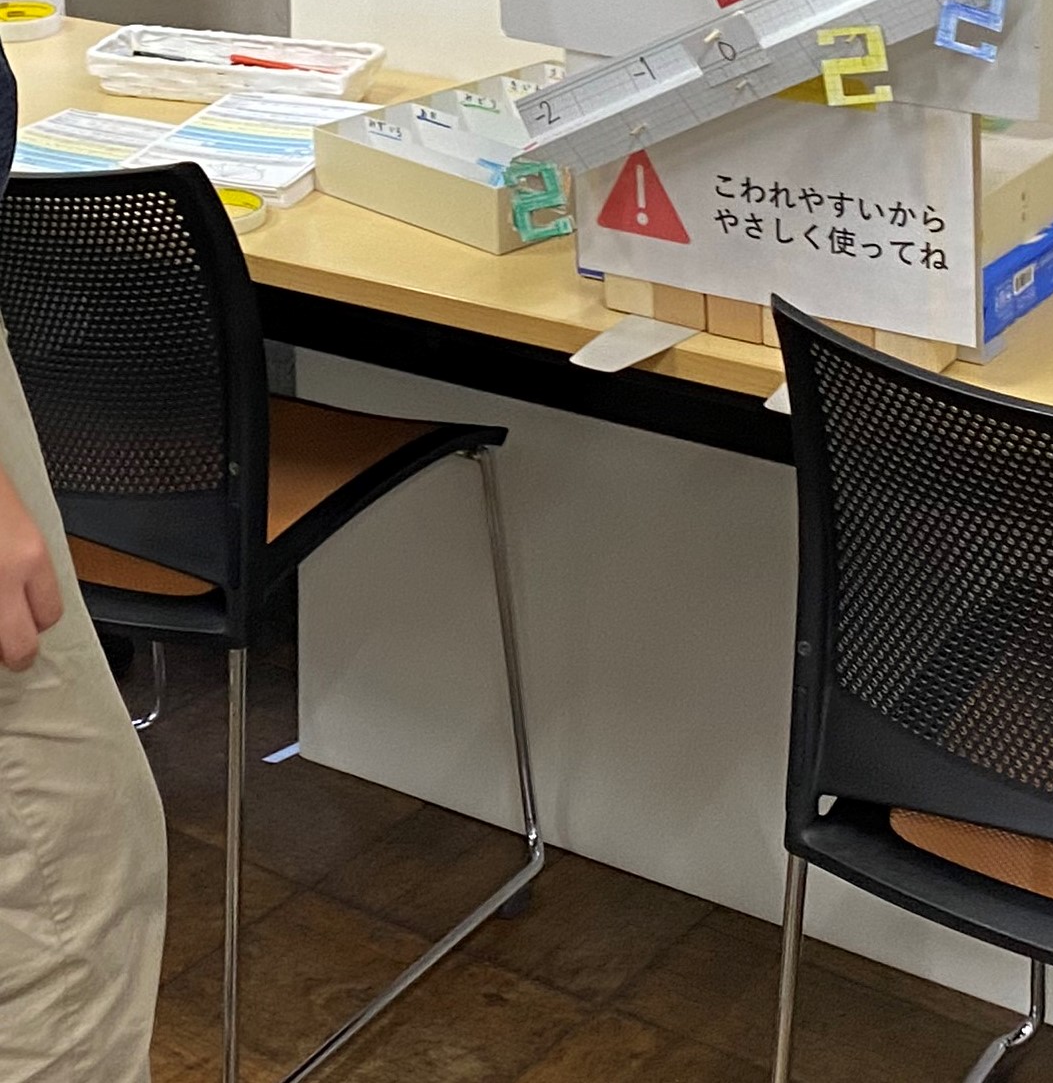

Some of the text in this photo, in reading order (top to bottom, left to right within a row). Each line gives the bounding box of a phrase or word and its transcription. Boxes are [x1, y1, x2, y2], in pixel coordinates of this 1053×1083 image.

[716, 41, 737, 62] 0
[633, 56, 657, 81] -1
[535, 100, 561, 125] -2
[714, 173, 946, 234] こわれやすいから
[714, 208, 949, 271] やさしく使ってね
